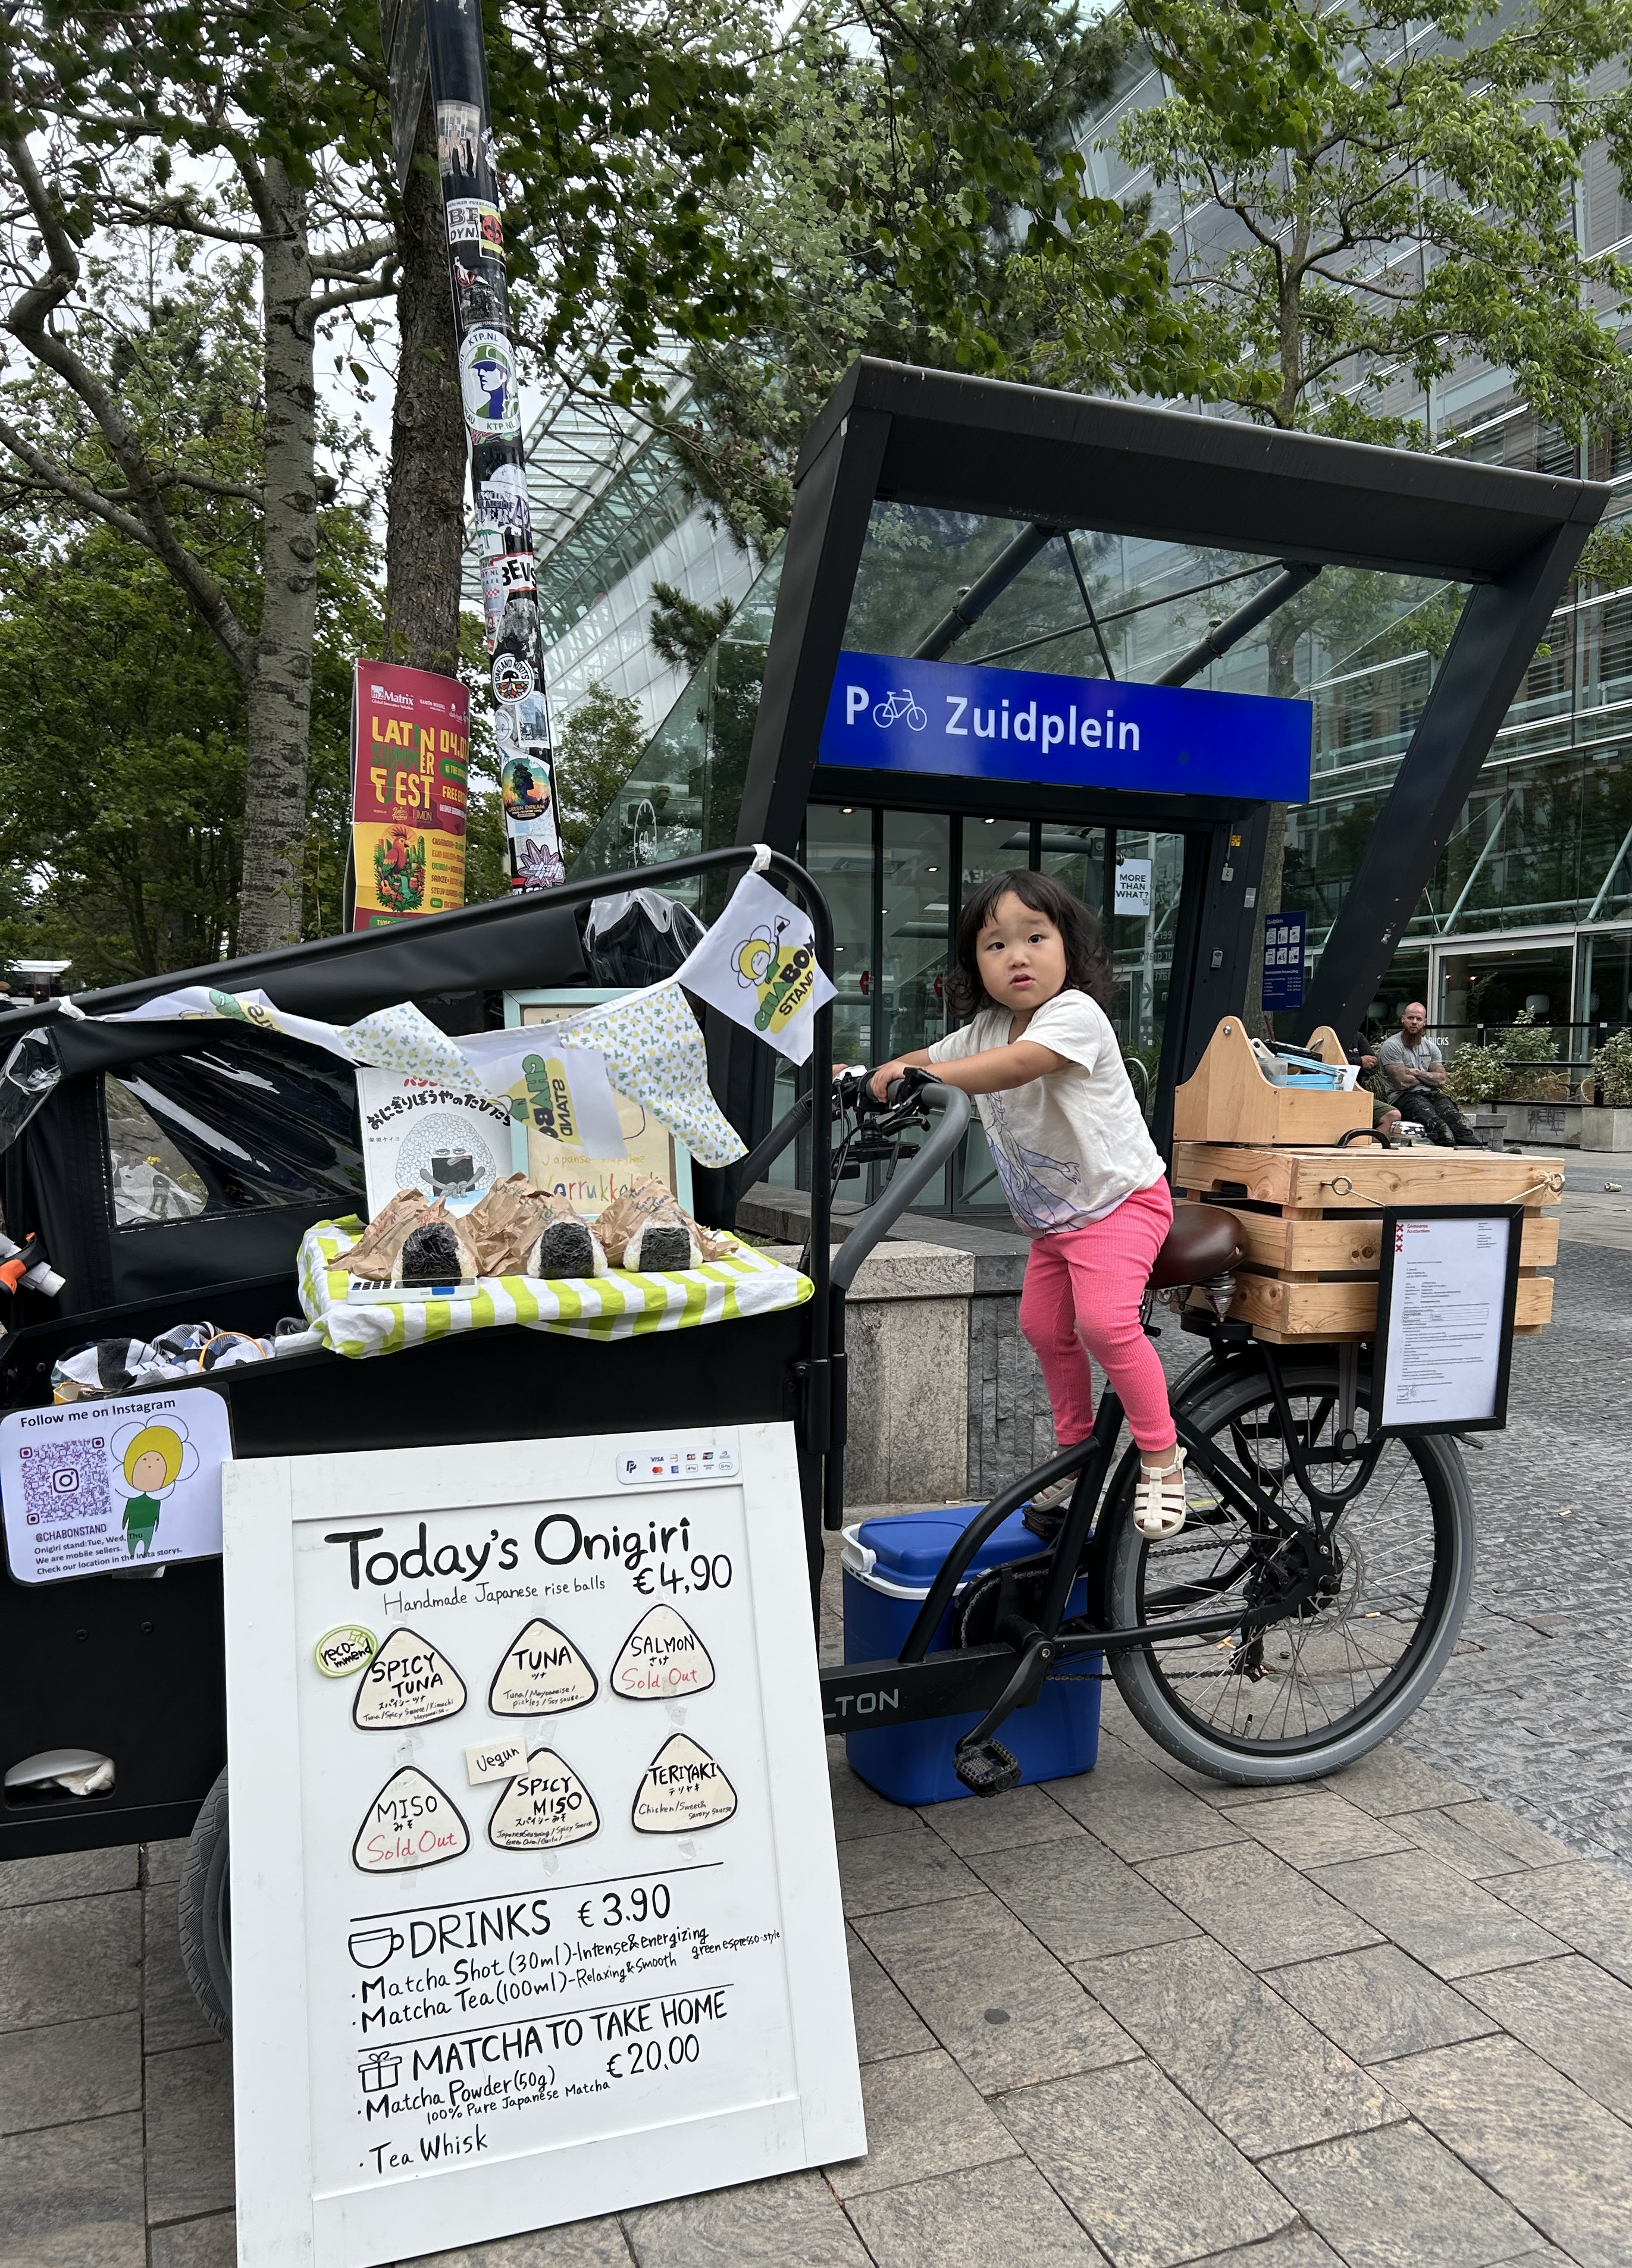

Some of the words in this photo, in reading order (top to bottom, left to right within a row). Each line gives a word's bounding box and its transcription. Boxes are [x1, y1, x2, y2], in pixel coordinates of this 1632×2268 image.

[468, 332, 499, 346] KTP.NL
[487, 420, 516, 431] KTP.NL
[495, 659, 512, 682] OAKLAND
[513, 661, 530, 680] ROOTS
[846, 685, 870, 725] P
[945, 695, 1141, 754] Zuidplein
[372, 716, 435, 751] LATIN
[442, 785, 458, 801] FREE
[1119, 874, 1147, 883] MORE
[1121, 882, 1146, 890] THAN
[1116, 890, 1149, 899] WHAT?
[779, 971, 815, 1016] STAND
[20, 1413, 64, 1428] Follow
[68, 1410, 89, 1422] me
[92, 1407, 109, 1418] on
[112, 1399, 176, 1417] Instagram
[35, 1544, 61, 1555] Onigiri
[105, 1535, 127, 1544] Wed,
[36, 1523, 107, 1543] @CHABONSTAND
[35, 1557, 49, 1565] We
[66, 1550, 93, 1561] mobile
[95, 1546, 123, 1555] sellers.
[37, 1566, 61, 1575] Check
[79, 1558, 110, 1569] location
[121, 1552, 134, 1561] the
[156, 1546, 183, 1557] storys.
[324, 1522, 518, 1590] Today's
[535, 1514, 690, 1570] Onigiri
[384, 1586, 468, 1615] Handmade
[475, 1582, 538, 1604] Japanese
[544, 1582, 570, 1596] rise
[574, 1574, 606, 1593] balls
[334, 1638, 374, 1669] mmend
[631, 1633, 695, 1657] SALMON
[371, 1652, 437, 1683] SPICY
[512, 1646, 572, 1671] TUNA
[649, 1655, 669, 1667] さけ
[391, 1673, 443, 1698] TUNA
[531, 1671, 547, 1680] ツナ
[621, 1668, 660, 1690] Sold
[669, 1667, 698, 1684] Out
[824, 1688, 899, 1720] TON
[516, 1775, 572, 1797] SPICY
[649, 1762, 718, 1787] TERIYAKI
[669, 1783, 700, 1796] テリヤキ
[377, 1795, 438, 1823] MISO
[534, 1792, 583, 1816] MISO
[393, 1819, 414, 1832] みそ
[515, 1812, 567, 1827] スパイシーみそ
[367, 1834, 415, 1864] Sold
[418, 1830, 457, 1853] Out
[411, 1899, 550, 1959] DRINKS
[577, 1883, 671, 1928] €3.90
[361, 1968, 451, 2003] Matcha
[454, 1959, 505, 1985] Shot
[691, 1943, 722, 1959] green
[362, 1998, 452, 2033] Matcha
[454, 1987, 494, 2012] Tea
[413, 2025, 544, 2081] MATCHA
[546, 2018, 583, 2050] TO
[589, 2003, 653, 2041] TAKE
[661, 1990, 728, 2028] HOME
[366, 2087, 445, 2122] Matcha
[427, 2107, 463, 2125] 100%
[467, 2100, 498, 2117] Pure
[502, 2089, 559, 2111] Japanese
[565, 2080, 611, 2097] Matcha
[369, 2141, 414, 2175] Tea
[420, 2123, 488, 2162] Whisk
